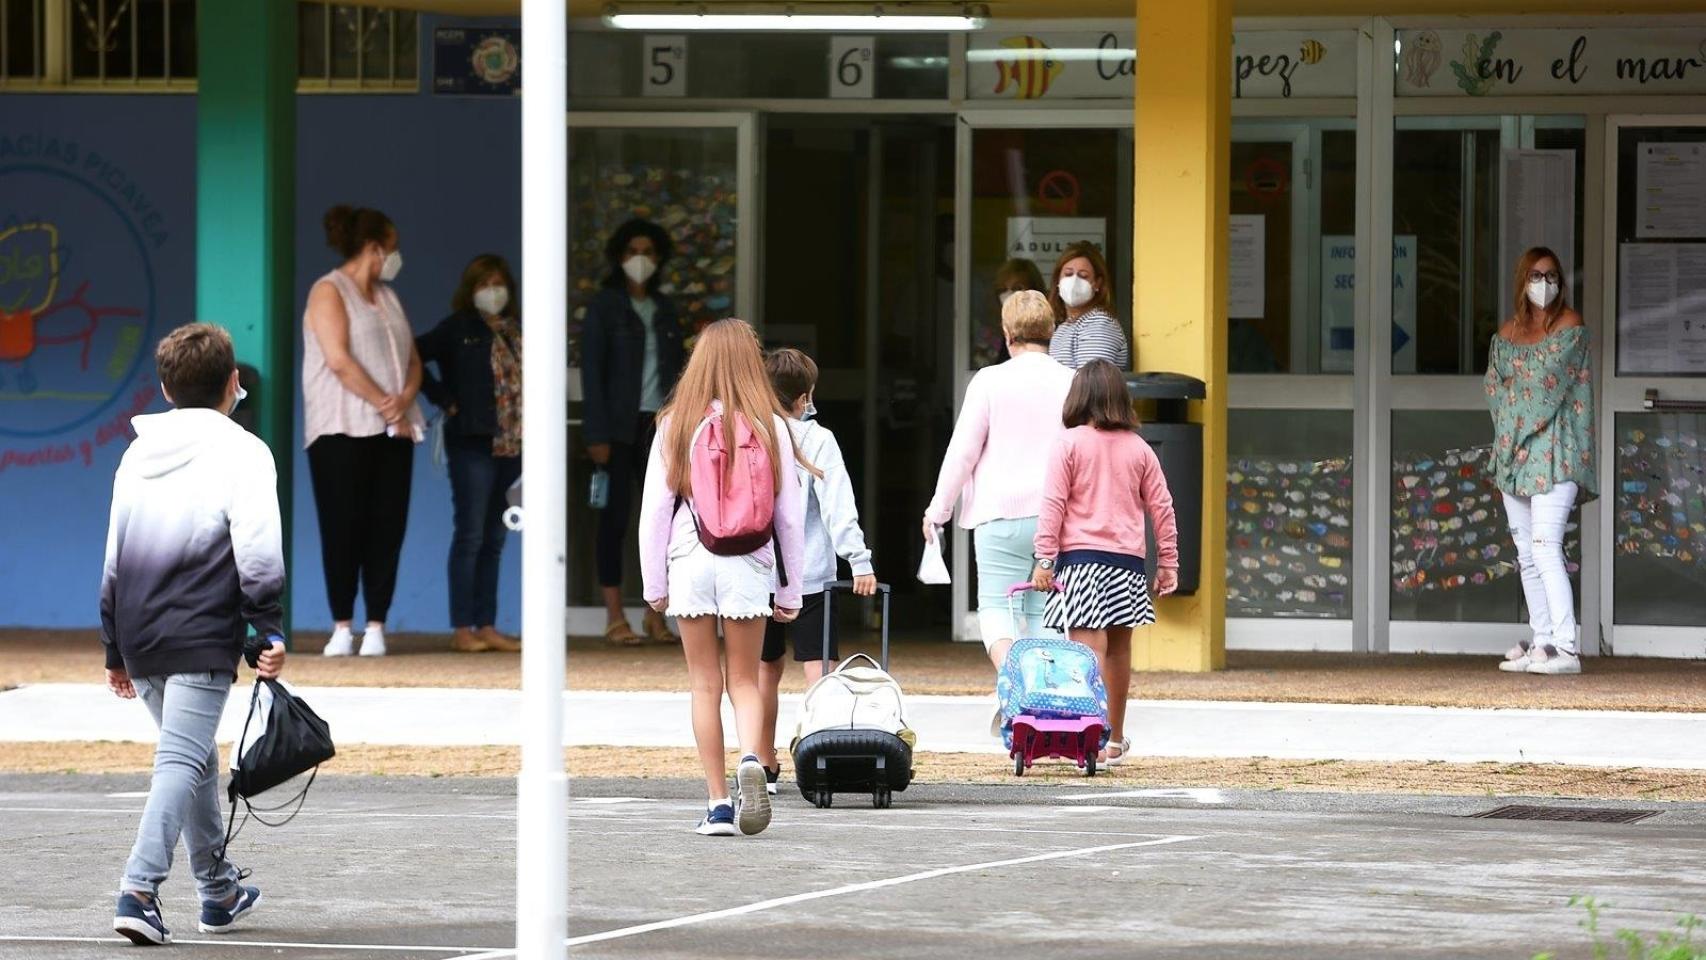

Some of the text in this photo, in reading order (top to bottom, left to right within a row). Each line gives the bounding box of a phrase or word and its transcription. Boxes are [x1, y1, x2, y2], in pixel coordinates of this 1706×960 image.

[1236, 54, 1299, 98] pez
[1478, 35, 1702, 84] en el mar
